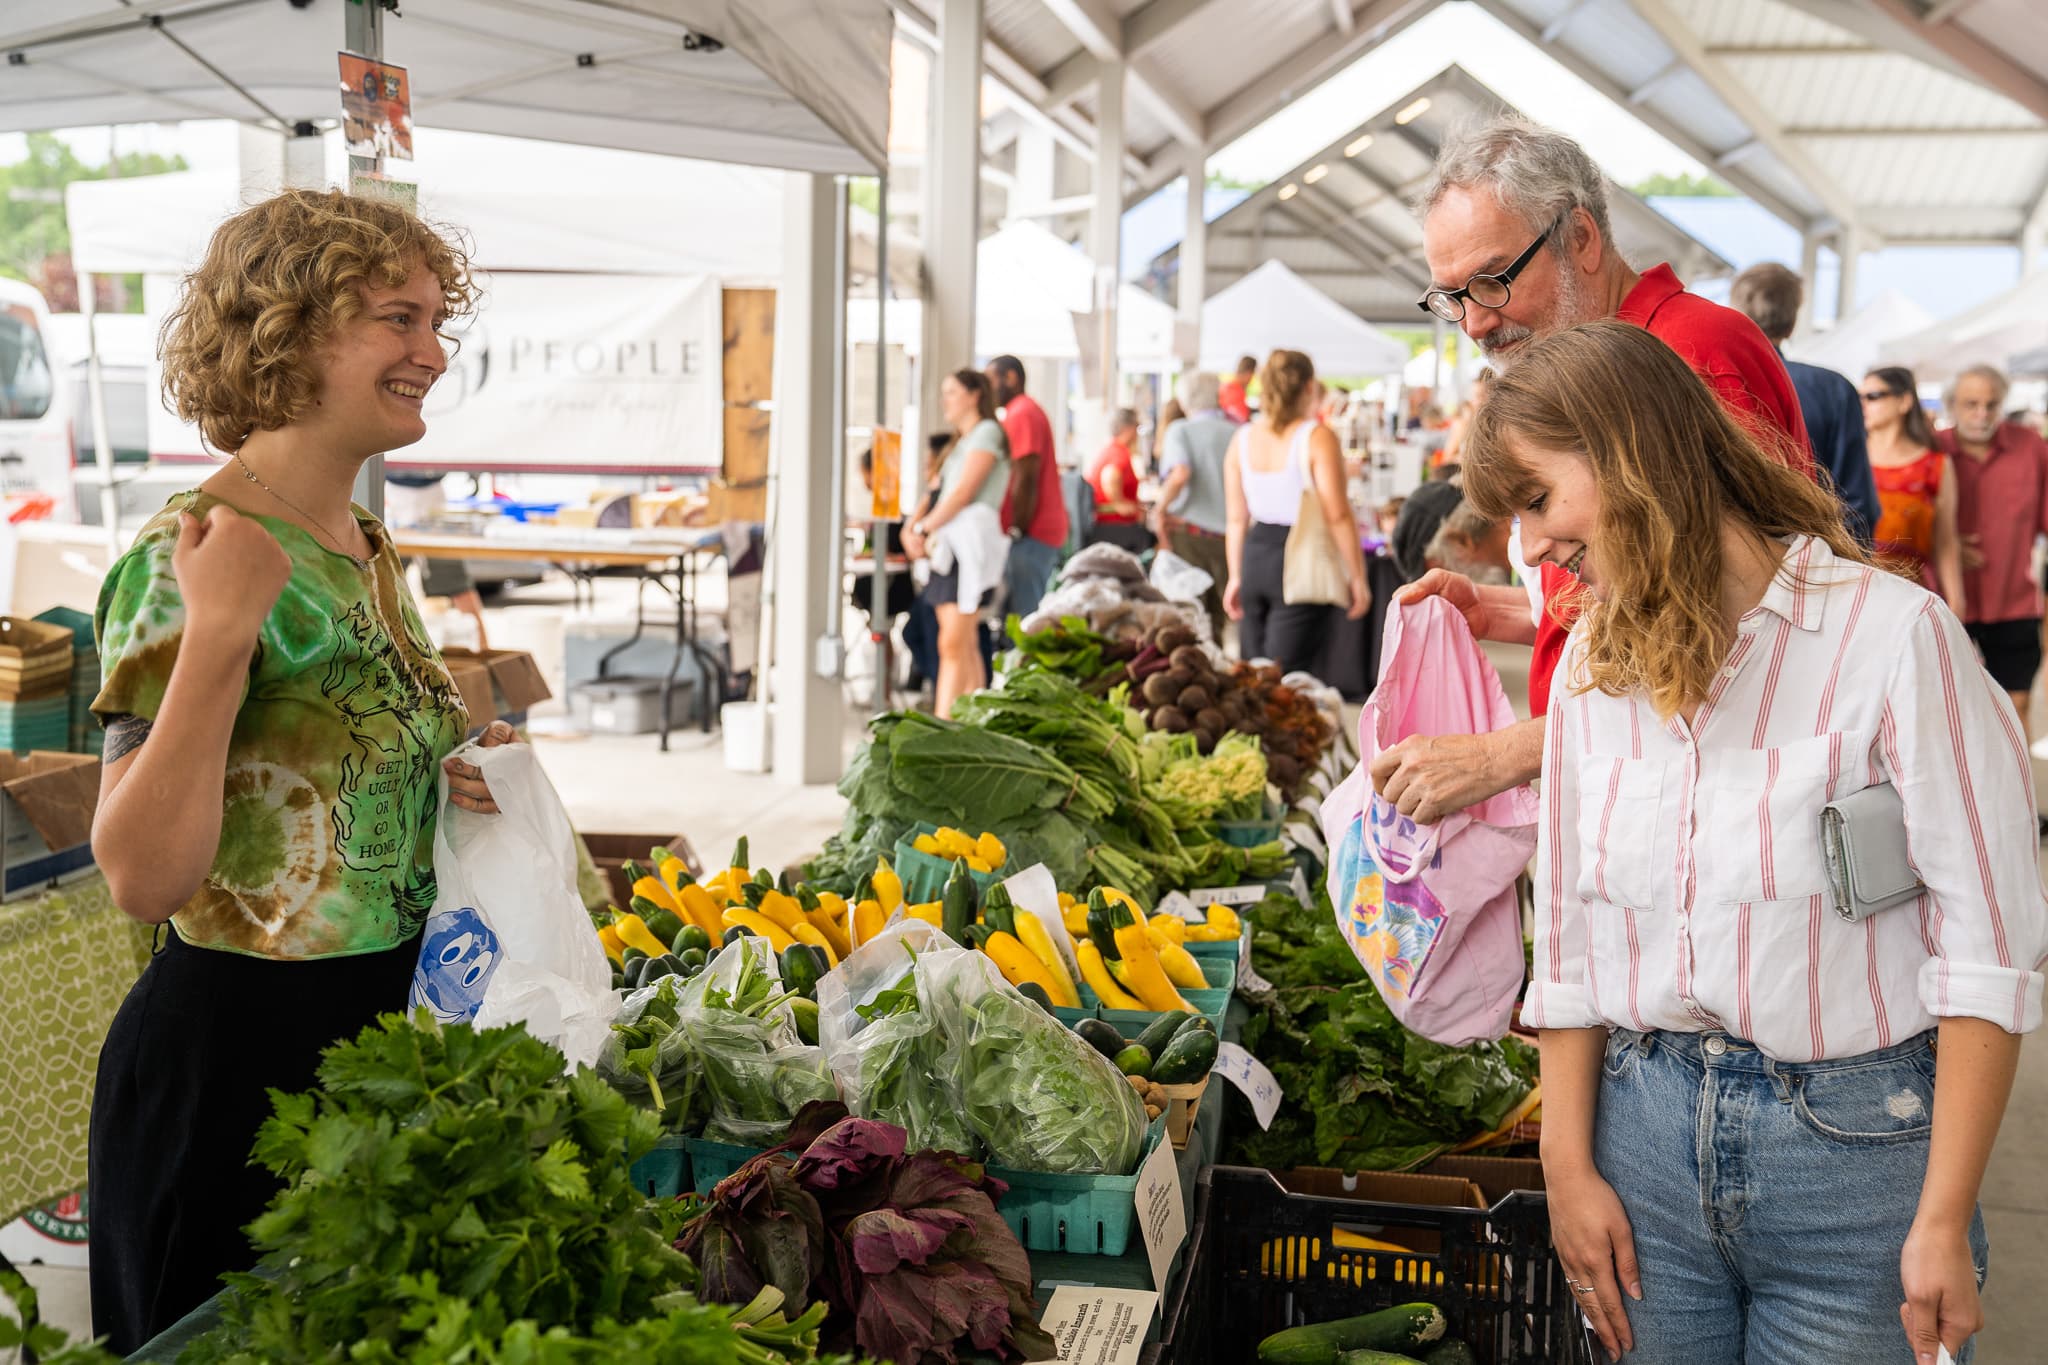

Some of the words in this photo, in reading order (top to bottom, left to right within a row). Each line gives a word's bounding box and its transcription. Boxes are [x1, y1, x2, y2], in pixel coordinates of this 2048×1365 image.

[376, 760, 402, 775] GET
[368, 779, 401, 796] UGLY
[376, 801, 389, 815] OR
[375, 821, 388, 836] GO
[359, 839, 396, 859] HOME
[1057, 1349, 1071, 1362] Red
